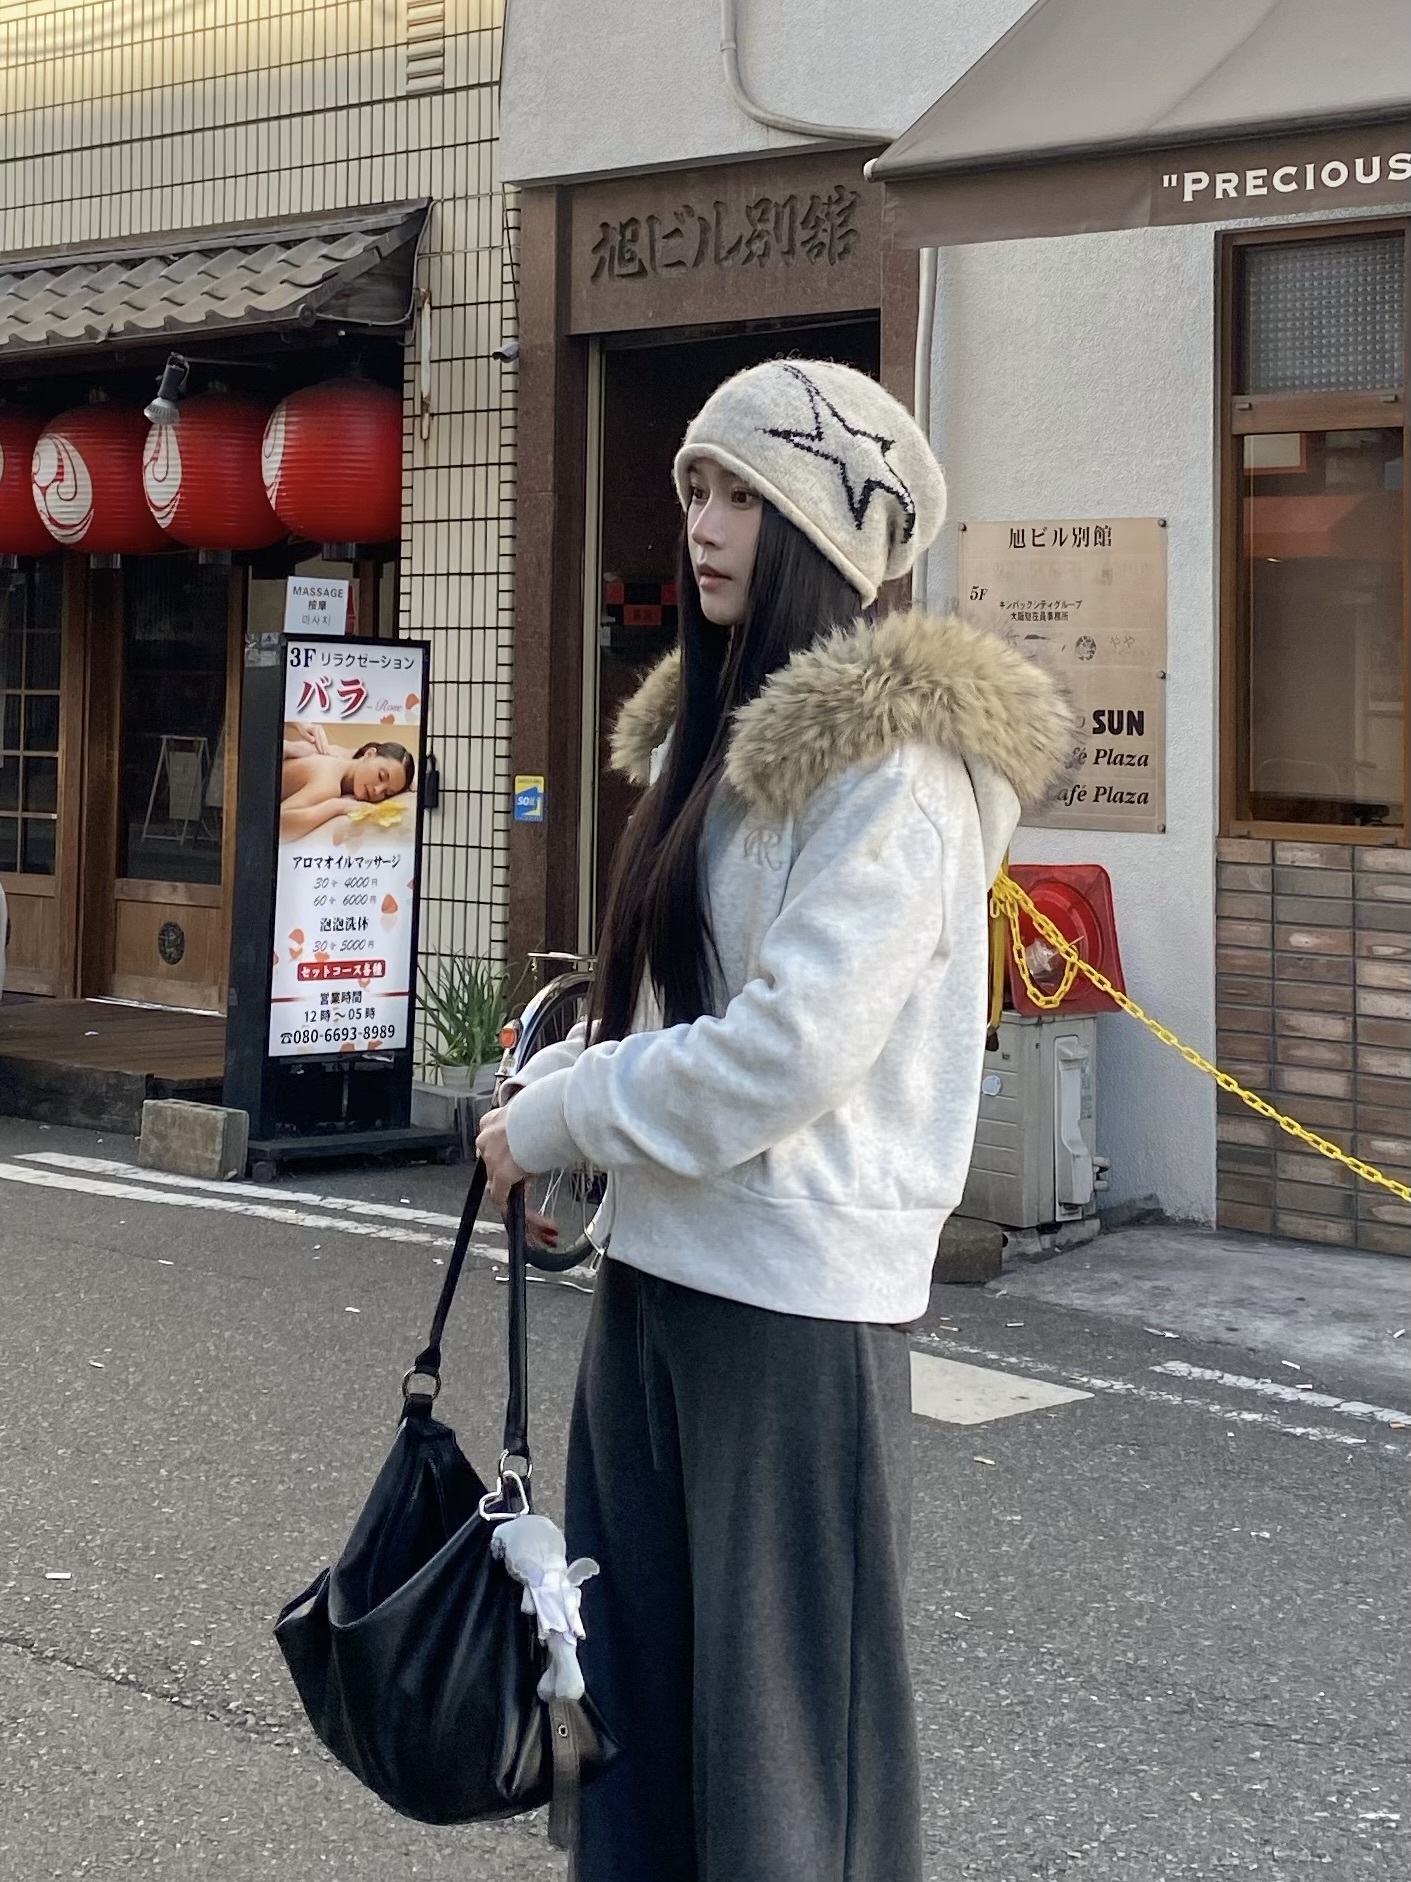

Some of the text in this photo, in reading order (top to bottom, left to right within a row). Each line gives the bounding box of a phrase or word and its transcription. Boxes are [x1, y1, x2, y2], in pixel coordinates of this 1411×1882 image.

[1008, 524, 1112, 550] 旭ビル別館
[293, 586, 344, 598] MASSAGE
[970, 586, 988, 600] 5F
[290, 647, 415, 670] 3F リラクゼーション
[297, 675, 368, 718] バラ
[1092, 709, 1145, 736] SUN
[1093, 748, 1149, 768] Plaza
[1057, 784, 1149, 807] afé Plaza
[292, 855, 401, 870] アロマオイルマッサージ
[319, 916, 369, 933] 泡泡洗体
[301, 962, 383, 979] セットコース各種
[320, 990, 362, 1006] 営業時間
